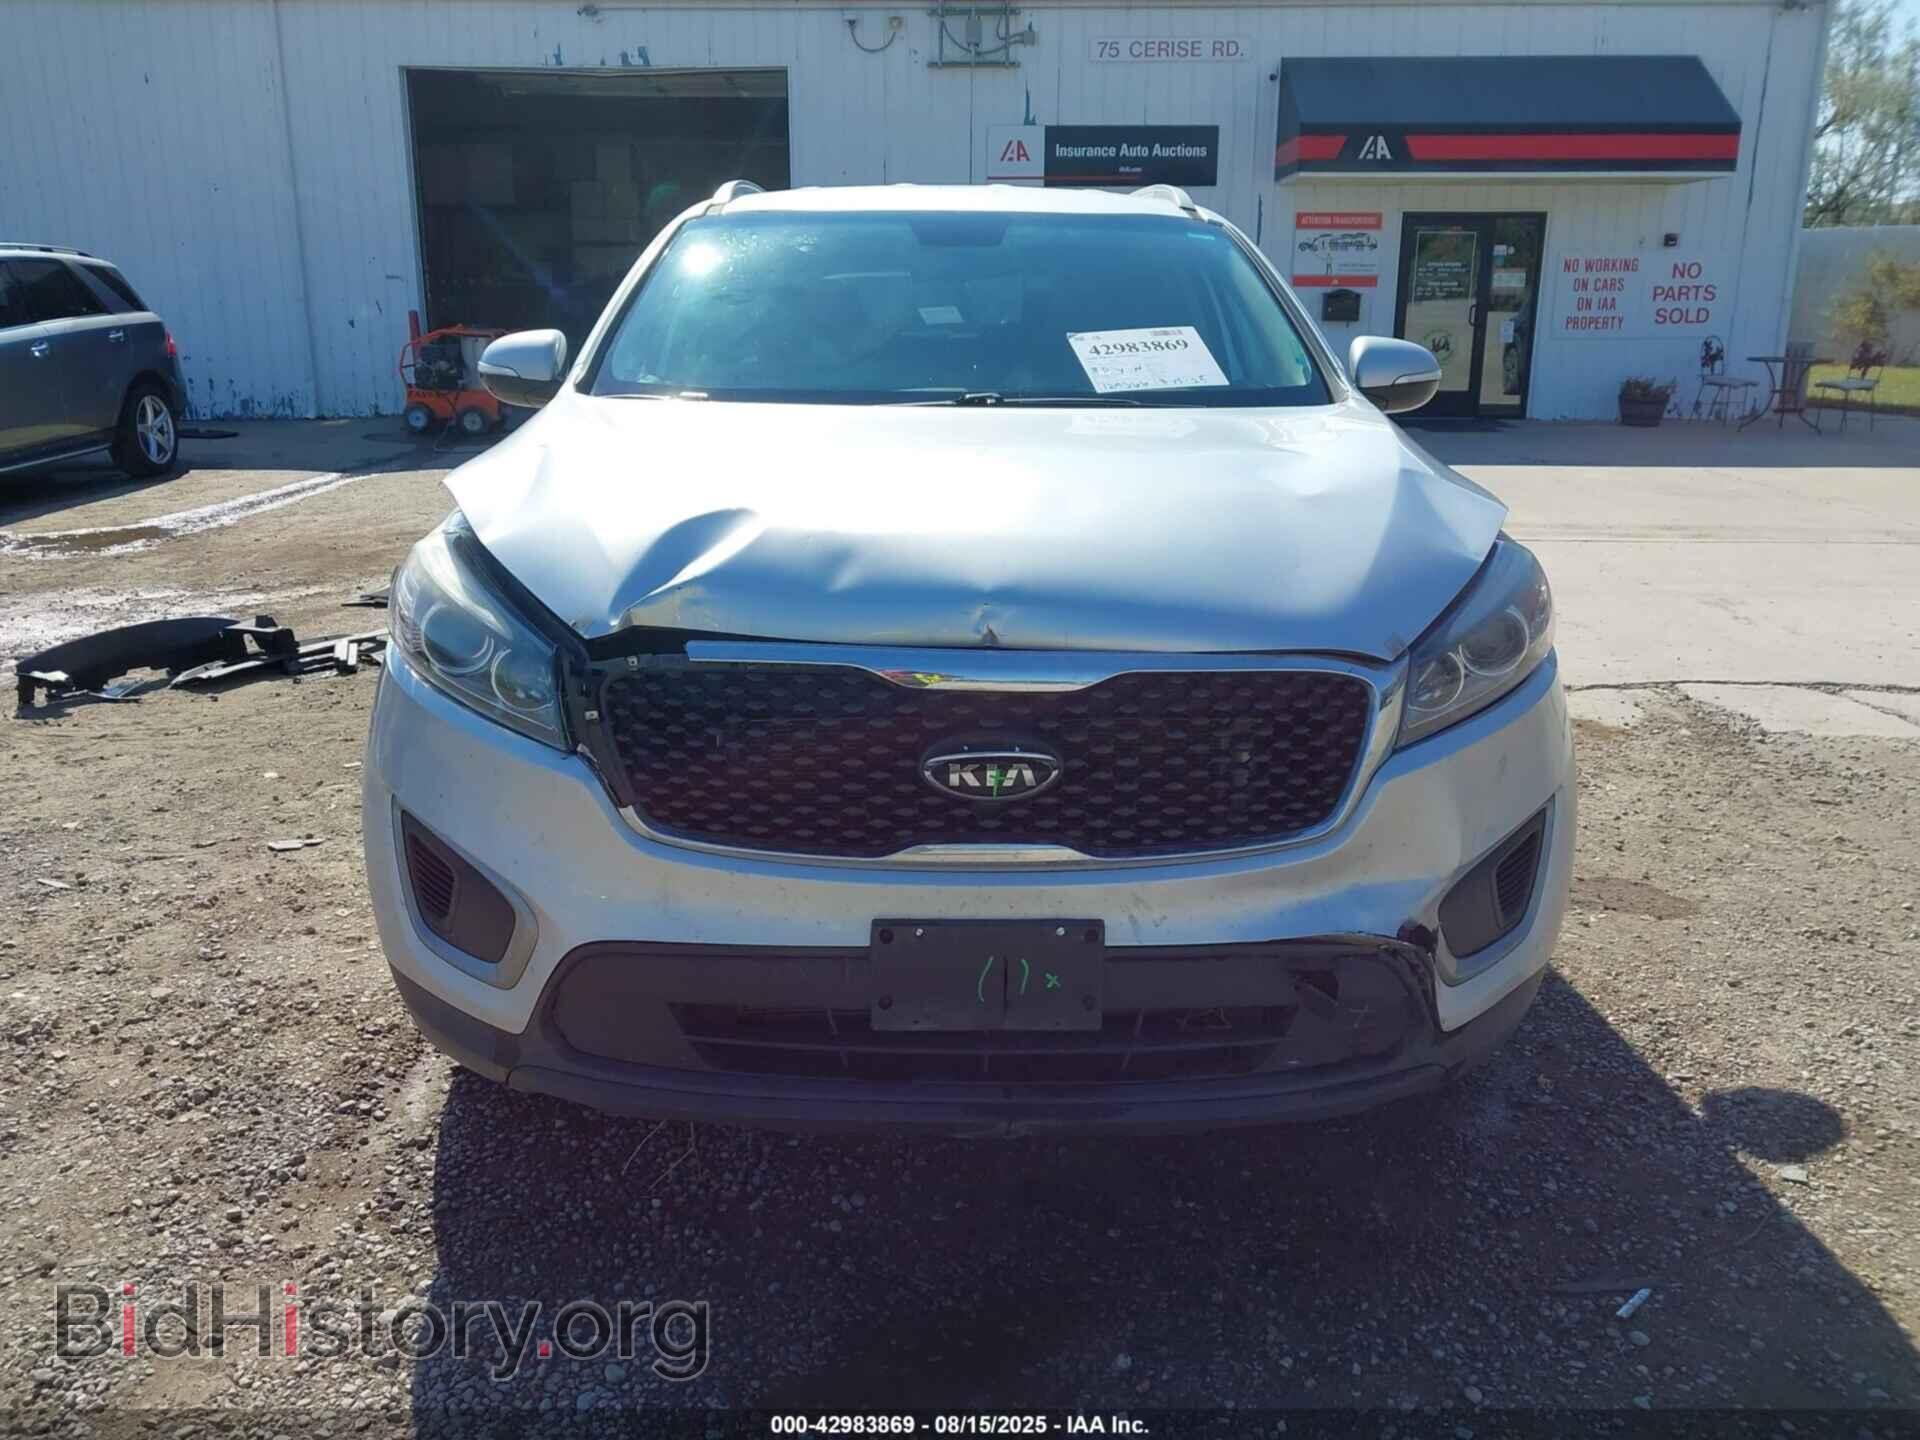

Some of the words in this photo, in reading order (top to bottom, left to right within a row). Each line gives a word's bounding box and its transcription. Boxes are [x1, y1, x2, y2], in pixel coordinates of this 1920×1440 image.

[1097, 41, 1120, 58] 75
[1129, 40, 1202, 58] CERISE
[1212, 40, 1244, 57] RD.
[1055, 143, 1116, 157] Insurance
[1119, 143, 1149, 157] Auto
[1152, 143, 1207, 158] Auctions
[1563, 259, 1580, 273] NO
[1584, 257, 1640, 273] WORKING
[1672, 262, 1703, 279] NO
[1573, 278, 1588, 292] ON
[1593, 277, 1625, 292] CARS
[1652, 284, 1718, 302] PARTS
[1577, 297, 1592, 312] ON
[1598, 296, 1617, 311] IAA
[1565, 315, 1624, 331] PROPERTY
[1655, 307, 1710, 325] SOLD
[1089, 338, 1189, 356] 42983869
[949, 763, 1037, 787] KIA
